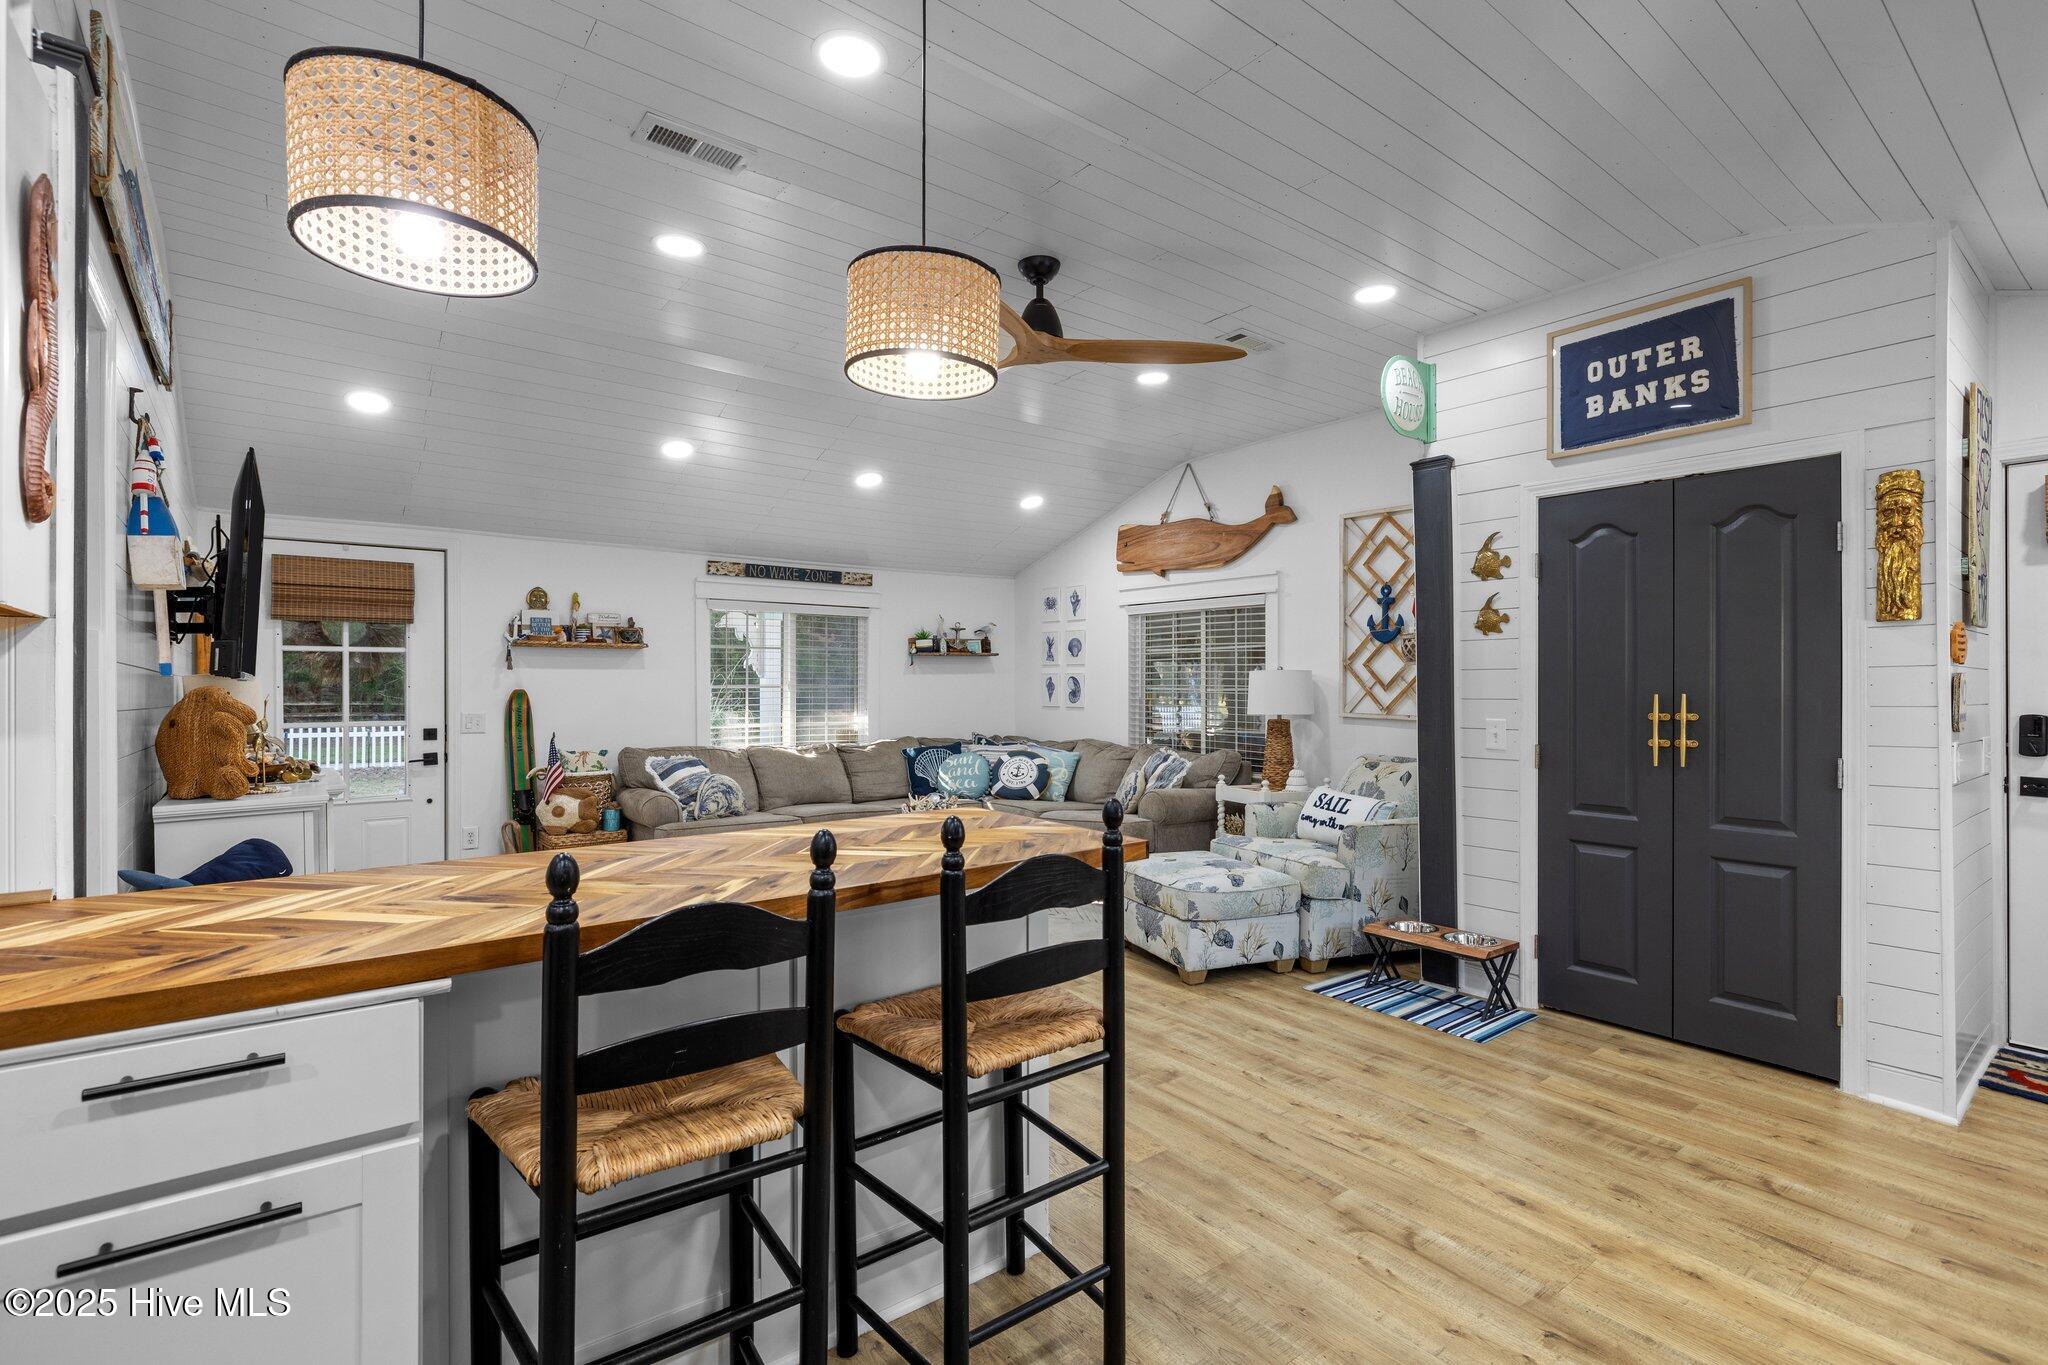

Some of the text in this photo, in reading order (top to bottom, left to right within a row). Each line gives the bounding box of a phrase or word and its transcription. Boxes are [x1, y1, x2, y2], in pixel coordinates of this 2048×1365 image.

[1586, 335, 1704, 383] OUTER
[1585, 368, 1711, 419] BANKS
[750, 565, 833, 583] NO WAKE ZONE
[948, 759, 981, 777] and
[1313, 793, 1351, 815] SAIL
[1300, 813, 1320, 829] away
[1319, 816, 1338, 830] with
